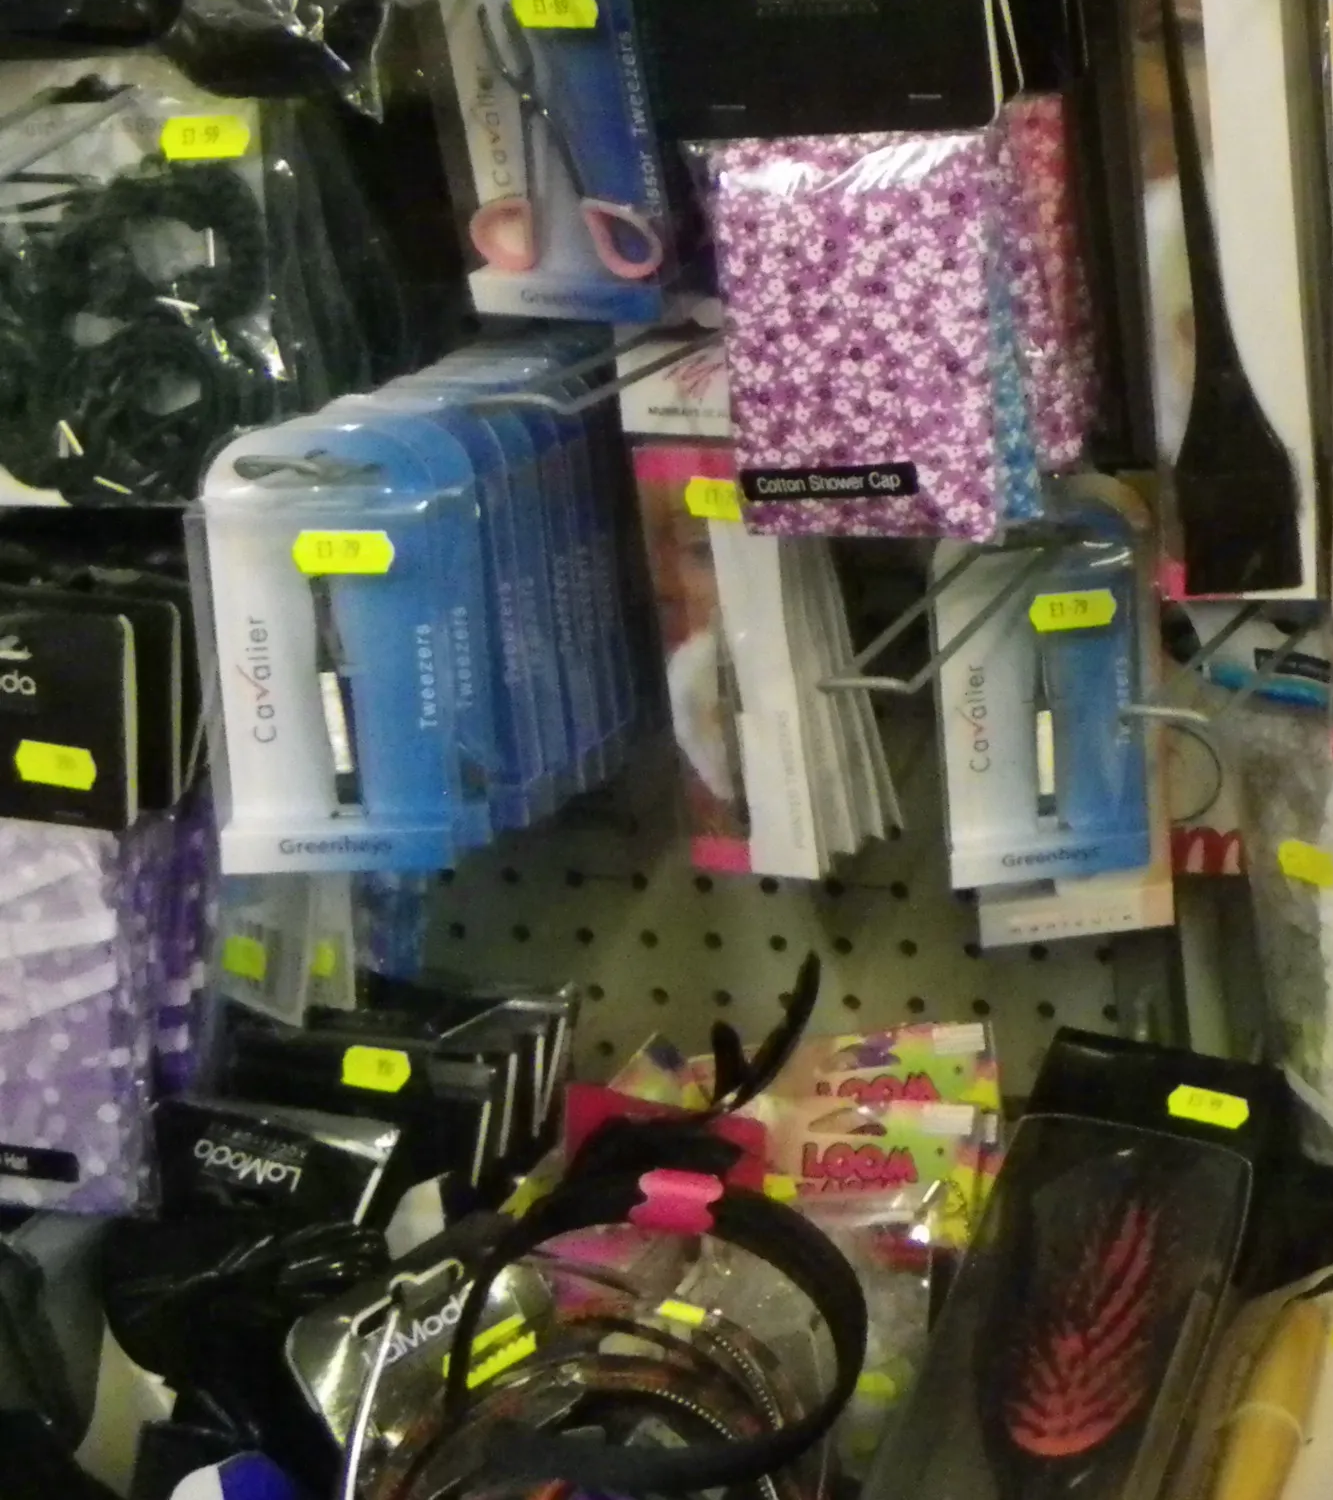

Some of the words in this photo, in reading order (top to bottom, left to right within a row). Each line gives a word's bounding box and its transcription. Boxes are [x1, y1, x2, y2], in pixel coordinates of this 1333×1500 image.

[614, 30, 648, 137] Tweezers
[638, 152, 664, 222] cissor
[756, 474, 804, 496] Cotton
[805, 472, 866, 494] Shower
[868, 470, 903, 491] Cap
[252, 614, 273, 744] Cavalier
[419, 621, 435, 730] Tweezers
[453, 606, 470, 709] Tweezers
[966, 662, 990, 774] Cavalier
[193, 1134, 303, 1193] LaModa
[802, 1141, 919, 1183] LOOM
